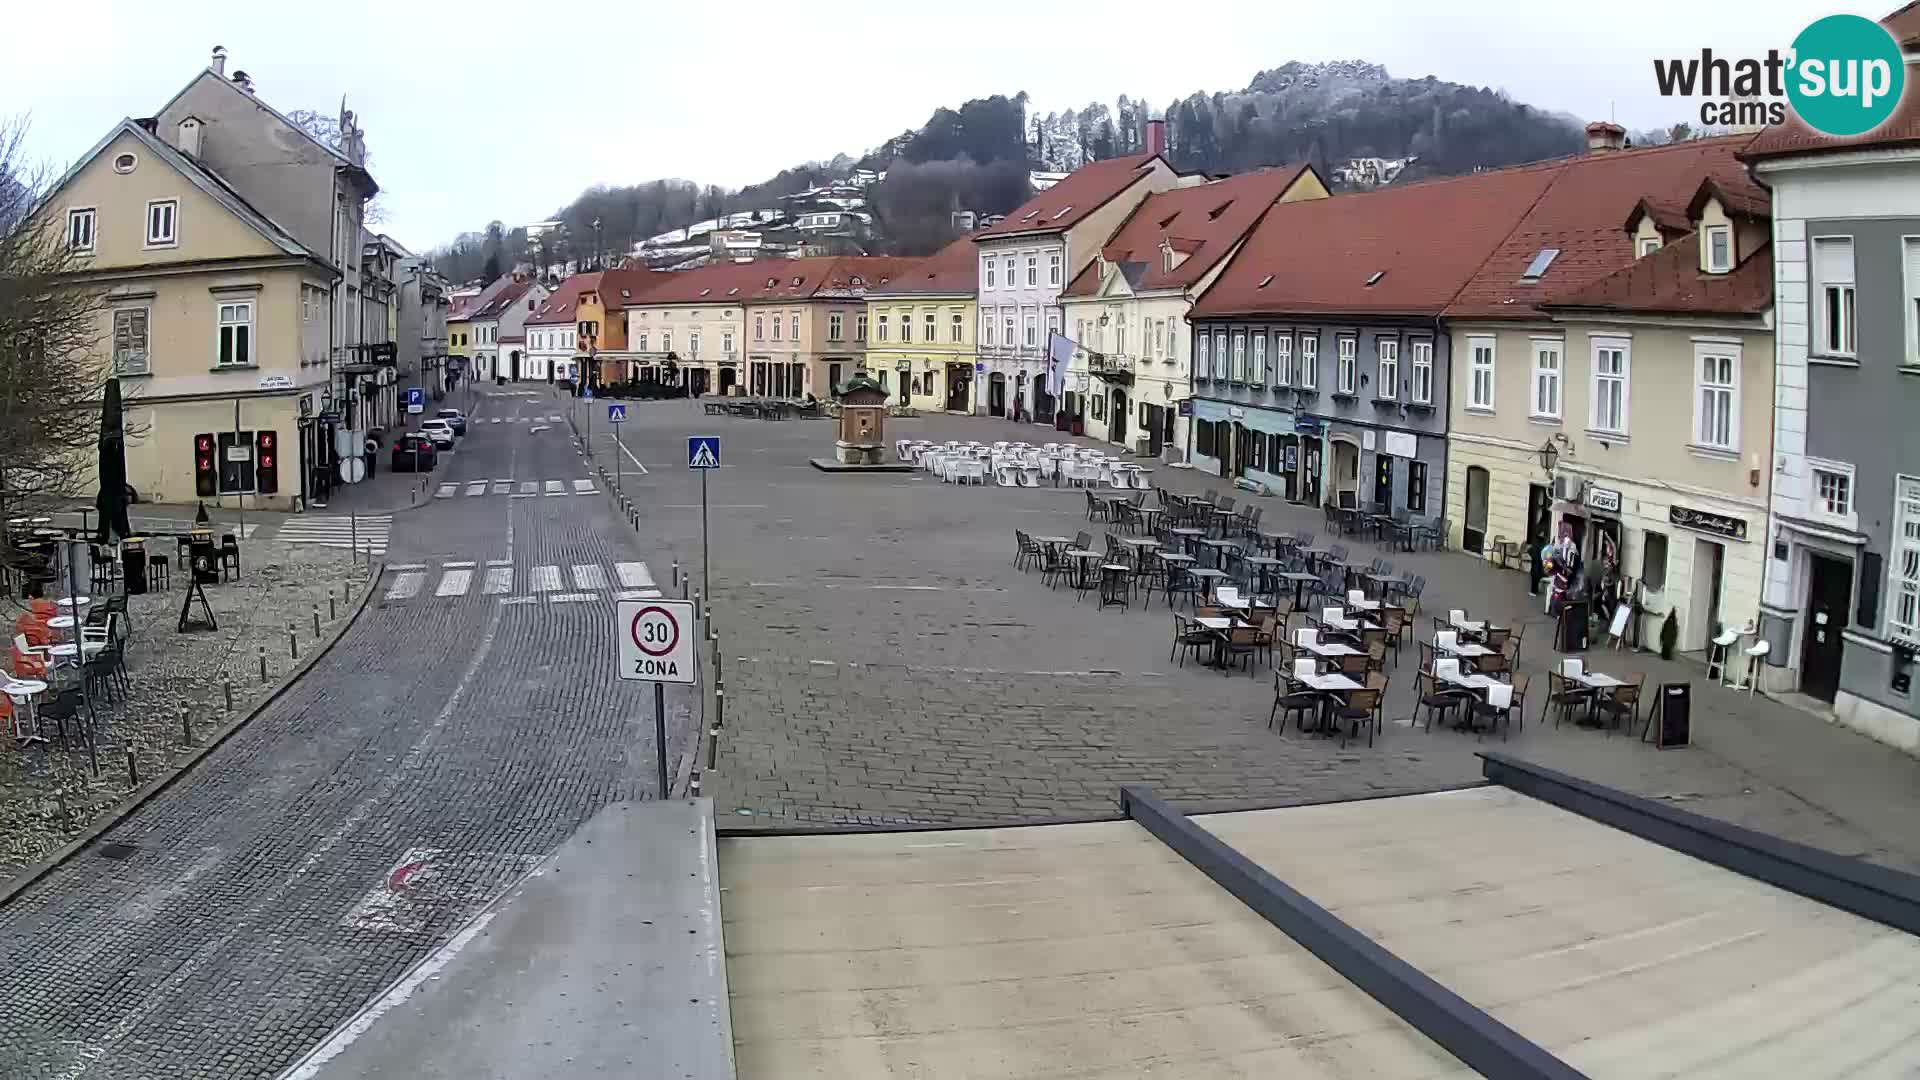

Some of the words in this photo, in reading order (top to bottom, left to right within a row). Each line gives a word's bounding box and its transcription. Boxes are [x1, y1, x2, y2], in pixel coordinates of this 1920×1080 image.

[411, 391, 420, 403] P
[644, 622, 668, 643] 30
[635, 659, 678, 676] ZONA
